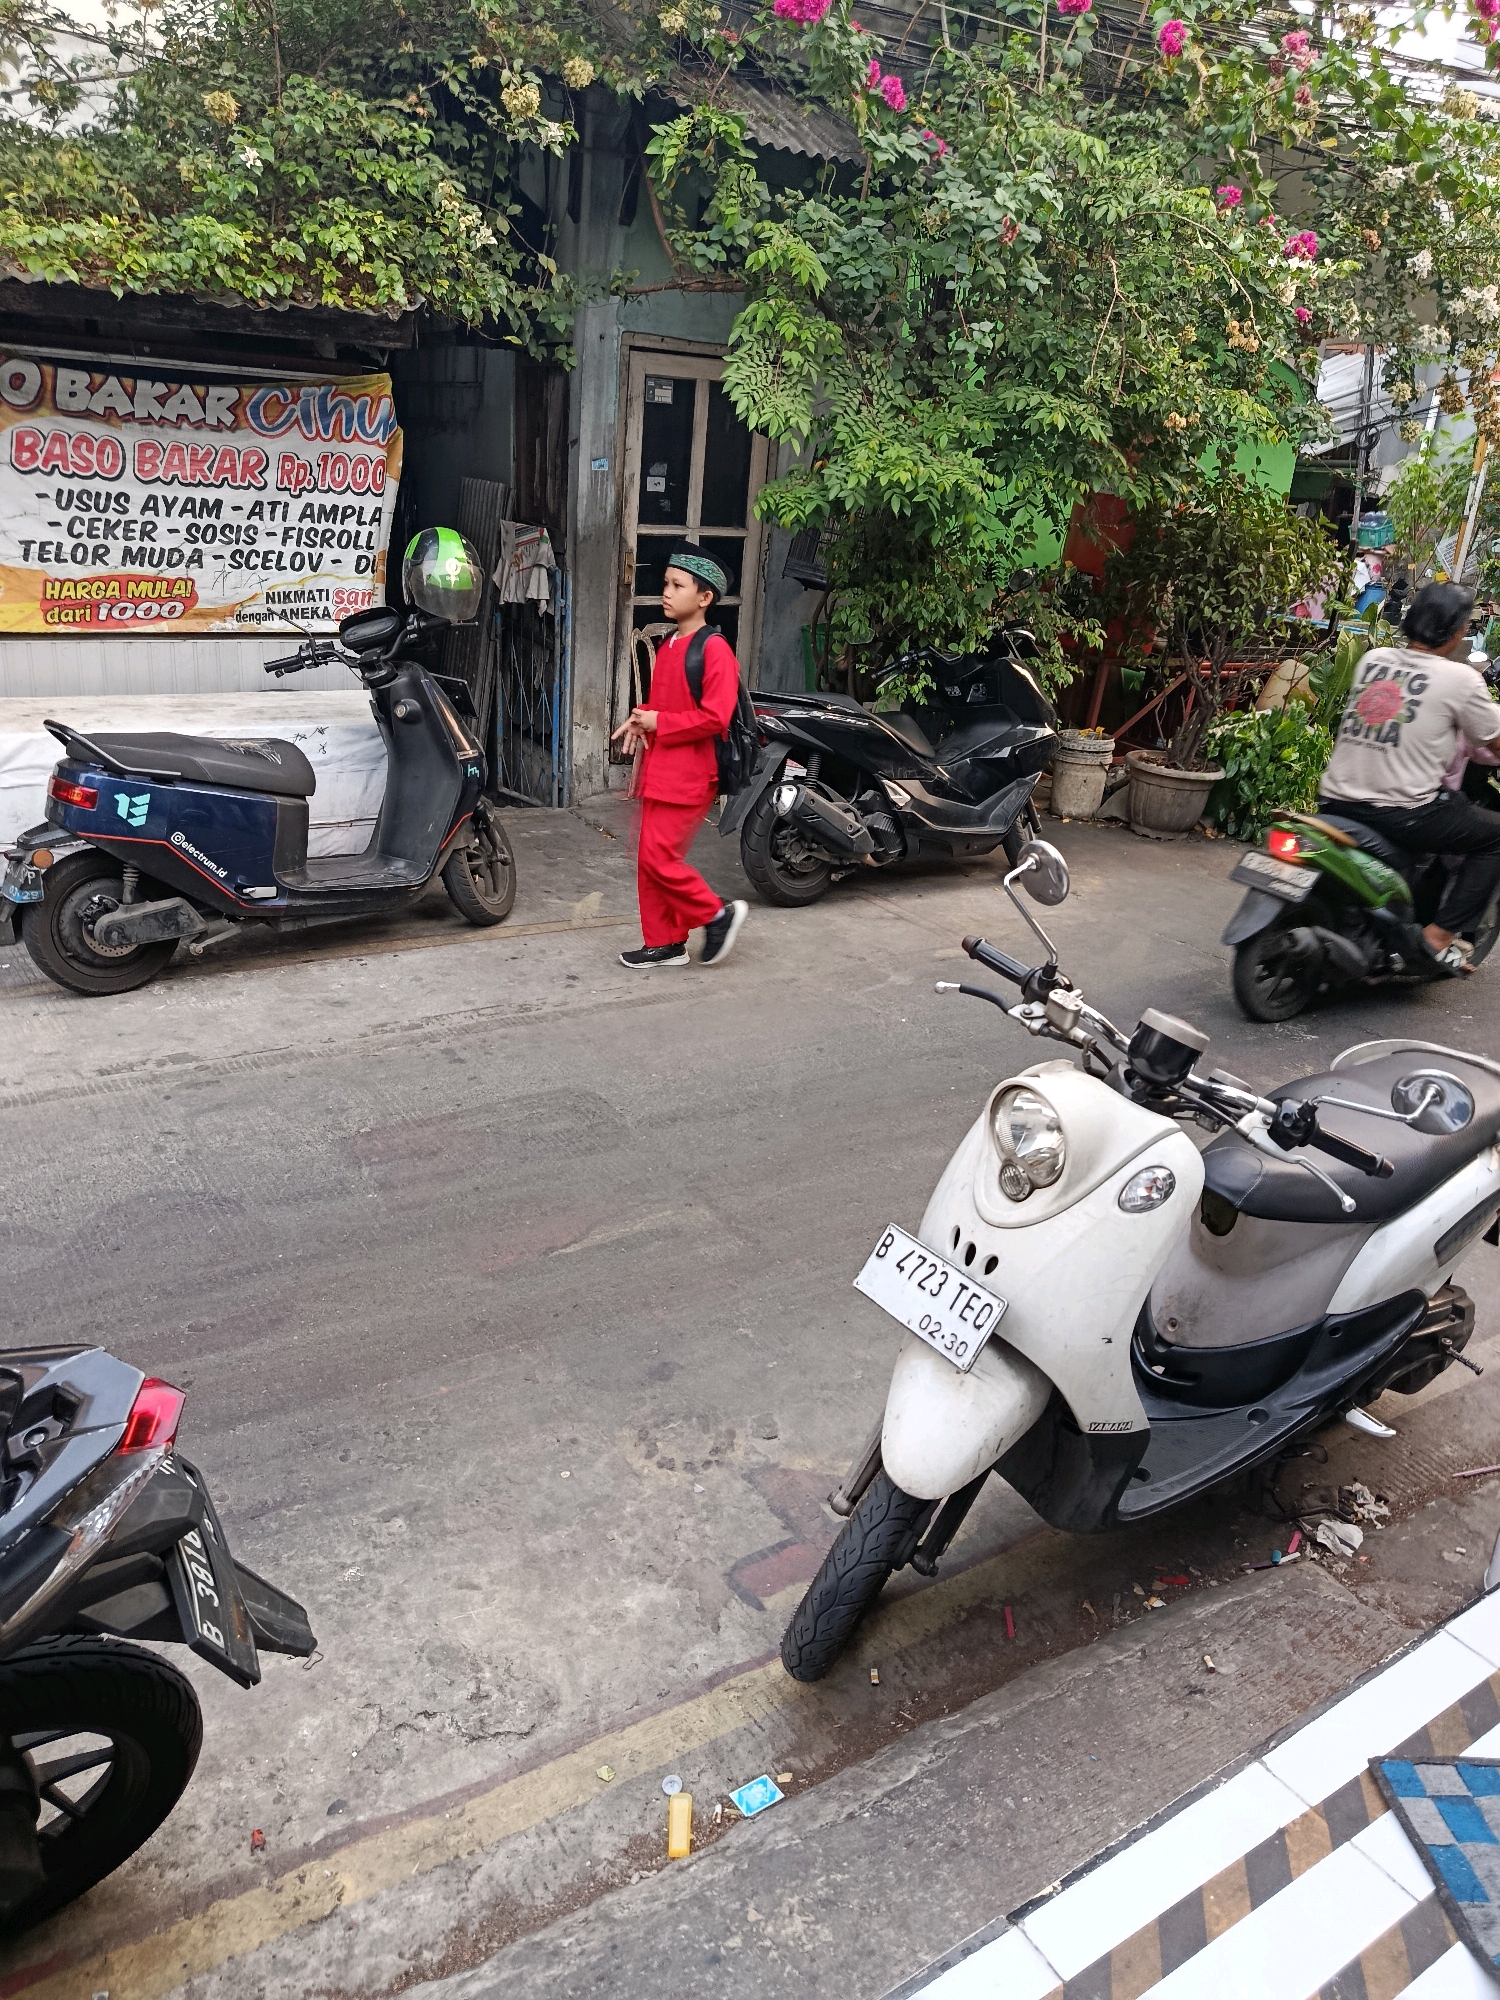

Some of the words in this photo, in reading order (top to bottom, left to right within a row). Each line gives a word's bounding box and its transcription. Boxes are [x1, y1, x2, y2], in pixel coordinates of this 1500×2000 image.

[54, 366, 240, 428] BAKAR
[11, 427, 126, 481] BASO
[133, 439, 268, 489] BAKAR
[140, 493, 223, 520] AYAM
[298, 502, 382, 527] AMPLA
[18, 540, 111, 566] TELOR
[121, 545, 204, 569] MUDA
[45, 580, 120, 600] HARGA
[127, 580, 193, 599] MULAI
[265, 588, 330, 605] NIKMATI
[46, 605, 91, 624] dari
[97, 602, 185, 621] 1000
[235, 610, 275, 625] dengan
[279, 606, 332, 620] ANEKA
[181, 841, 228, 878] electrum.id
[875, 1232, 895, 1258] B
[895, 1250, 949, 1297] 4723
[949, 1283, 994, 1331] TEQ
[1088, 1421, 1133, 1431] YAMAHA
[202, 1620, 225, 1649] B
